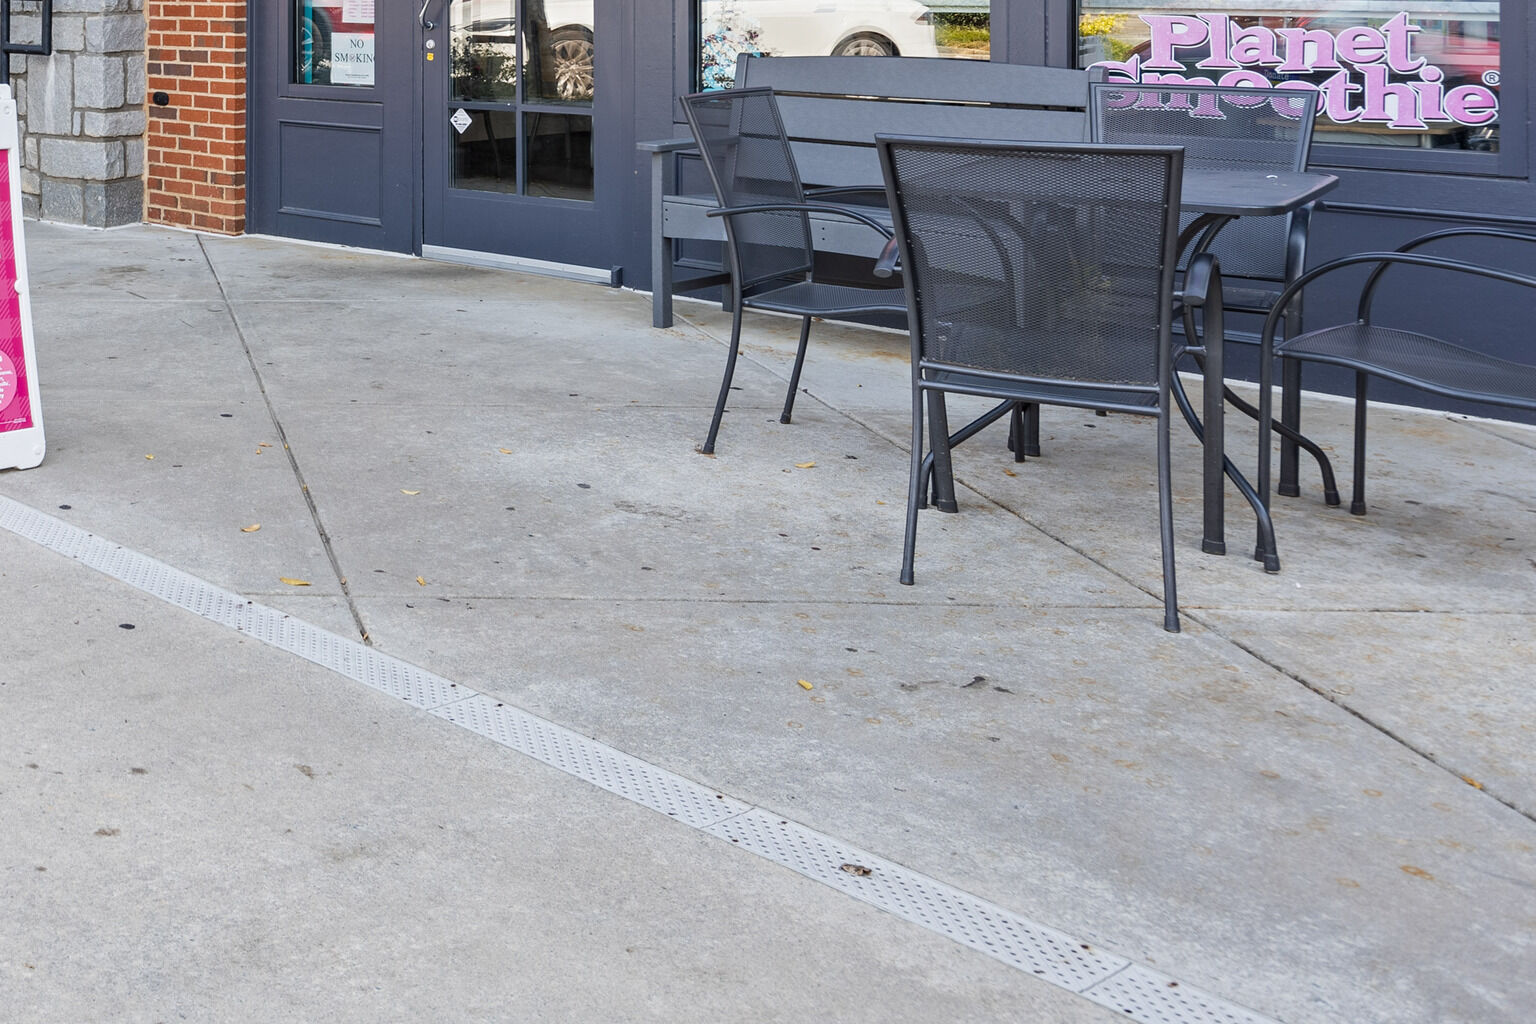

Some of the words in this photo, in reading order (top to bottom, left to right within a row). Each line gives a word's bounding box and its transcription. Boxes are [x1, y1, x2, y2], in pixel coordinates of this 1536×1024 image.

[350, 39, 364, 48] NO
[1140, 10, 1426, 73] Planet
[334, 53, 374, 63] SMOKIN
